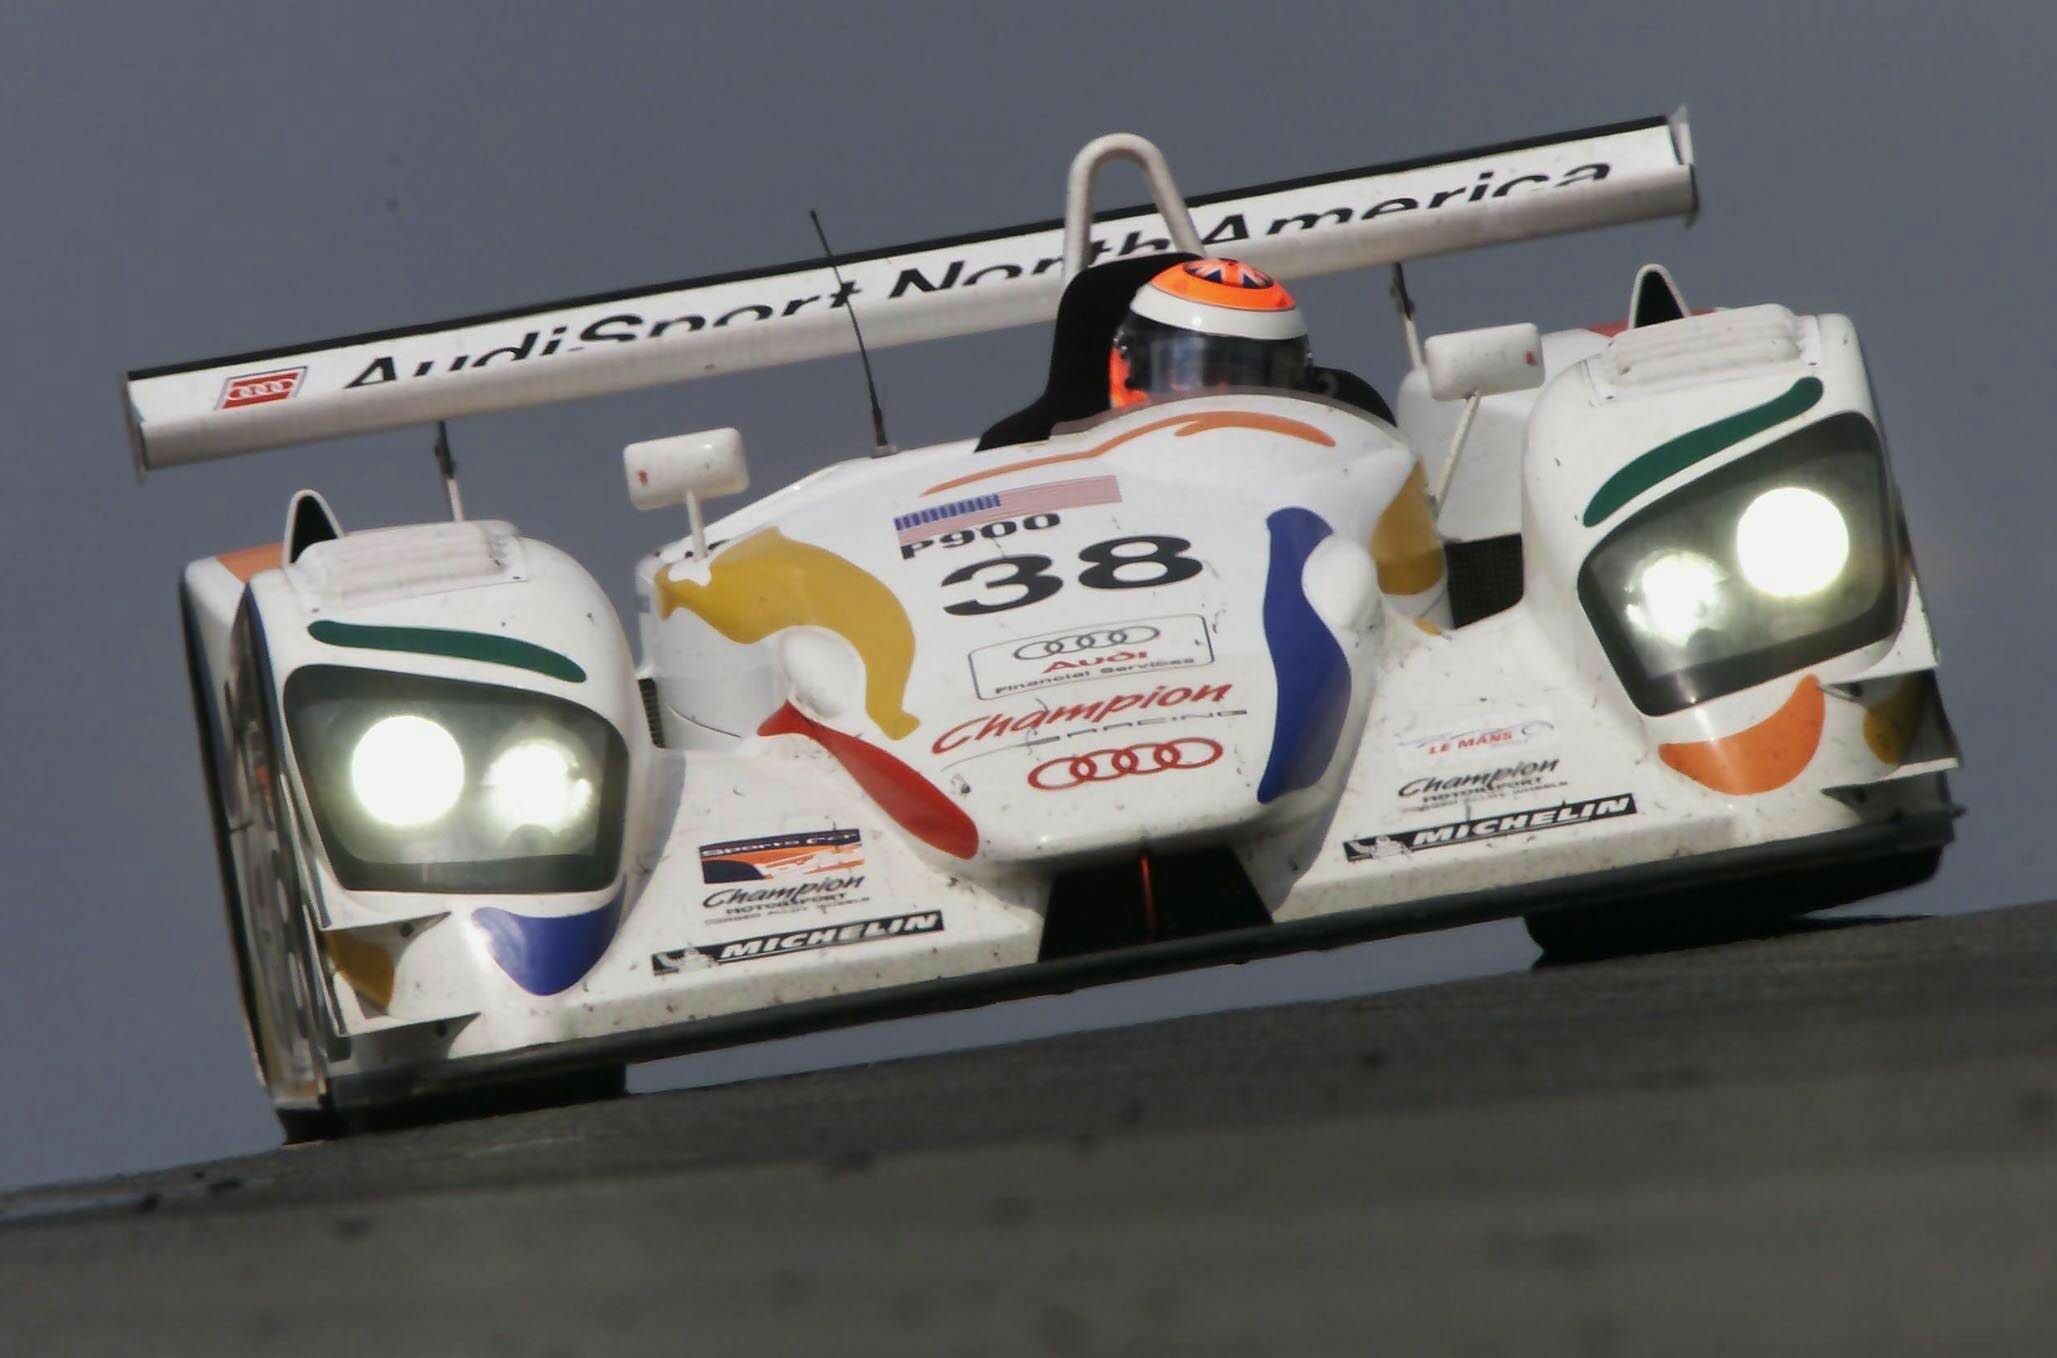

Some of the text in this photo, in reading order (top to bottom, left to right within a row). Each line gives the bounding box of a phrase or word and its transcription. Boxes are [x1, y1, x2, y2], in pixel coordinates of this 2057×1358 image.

[900, 513, 1061, 560] P900
[940, 534, 1203, 616] 38
[994, 658, 1195, 694] Financial Services
[931, 682, 1233, 755] Champion
[1428, 743, 1451, 755] LE
[1458, 730, 1513, 749] MANS
[1398, 757, 1560, 798] Champion
[1411, 796, 1631, 847] MICHELIN
[702, 875, 866, 909] Champion
[718, 913, 941, 961] MICHELIN
